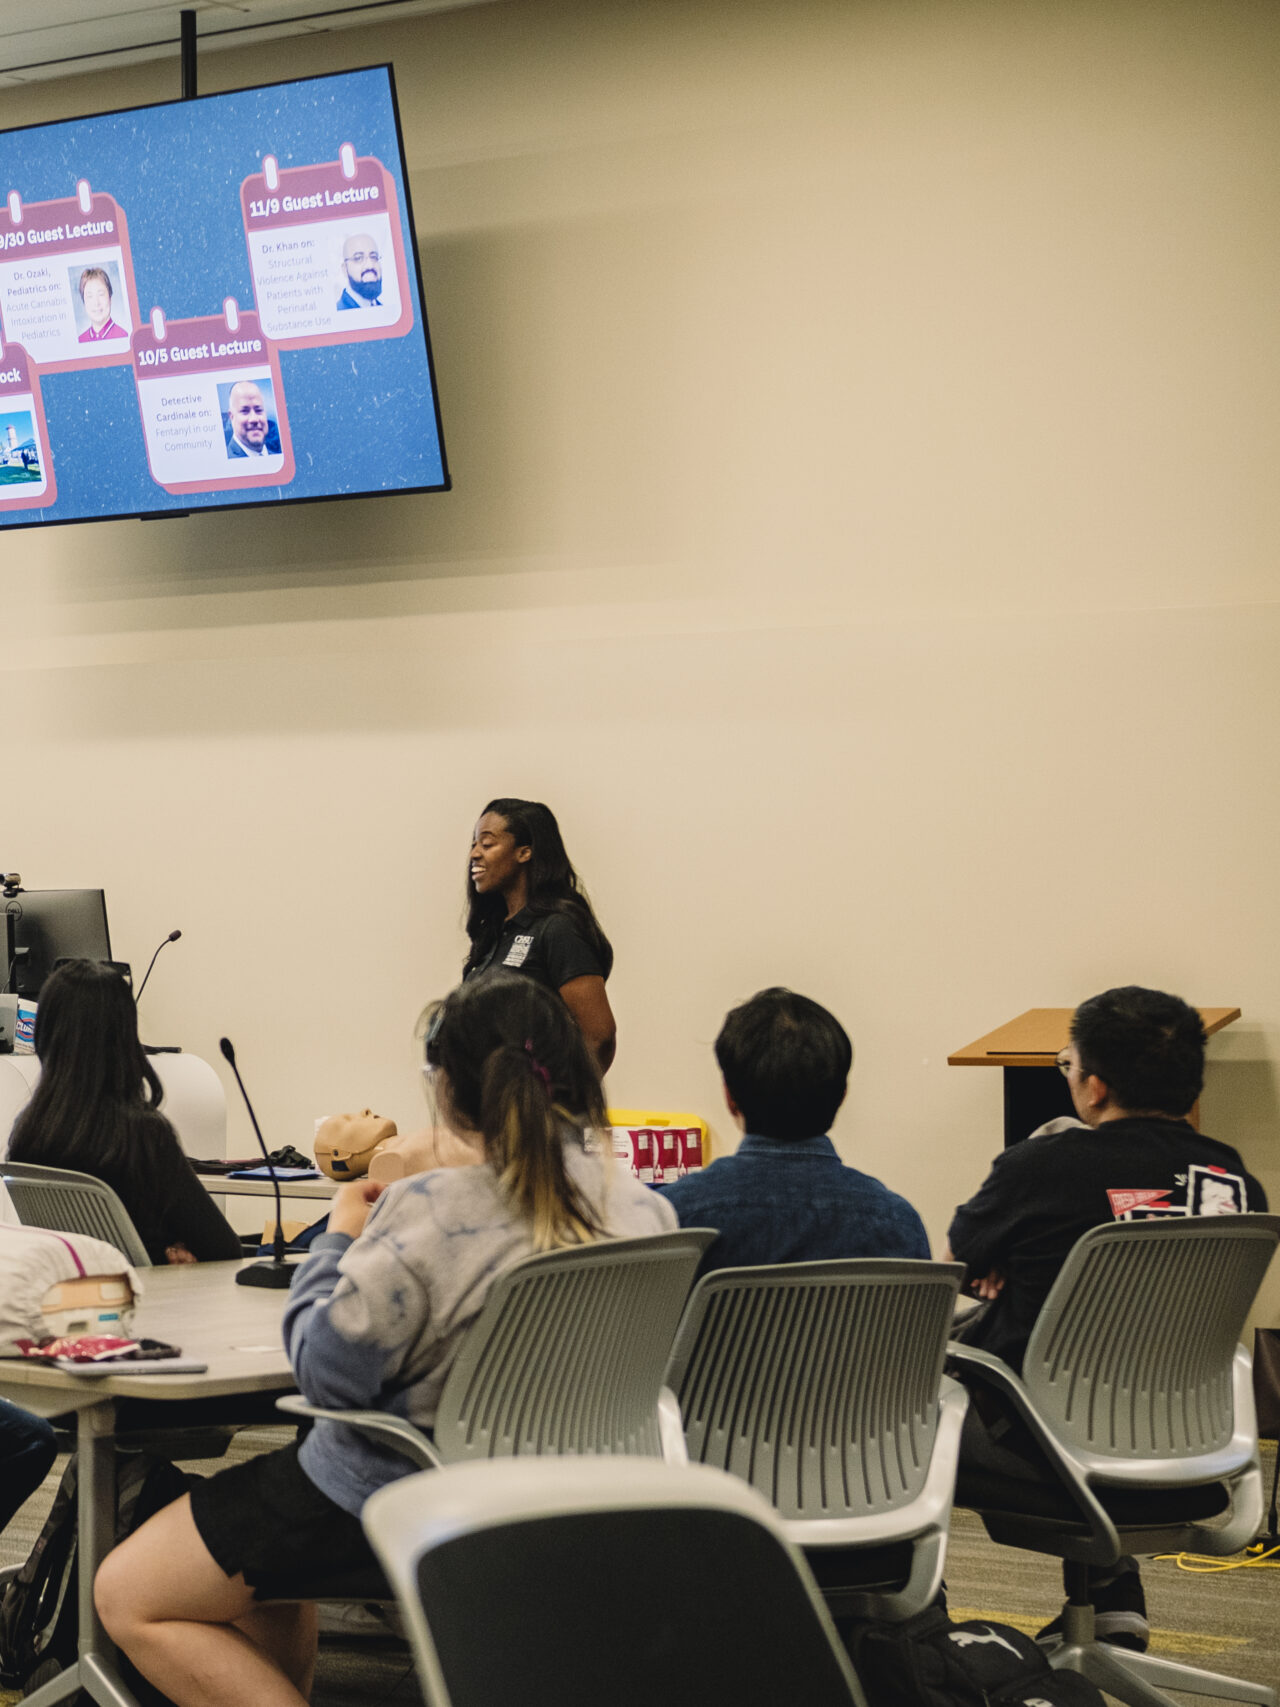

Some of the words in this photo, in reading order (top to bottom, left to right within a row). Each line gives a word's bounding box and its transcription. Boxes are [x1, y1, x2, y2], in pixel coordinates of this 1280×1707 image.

[250, 198, 280, 217] 11/9
[282, 192, 324, 212] Guest
[324, 186, 379, 206] Lecture
[27, 226, 64, 244] Guest
[65, 220, 114, 239] Lecture
[262, 244, 273, 254] Dr.
[276, 241, 299, 251] Khan
[300, 239, 315, 249] on:
[268, 255, 313, 269] Structural
[13, 271, 24, 281] Dr.
[257, 273, 294, 286] Violence
[296, 269, 328, 283] Against
[7, 285, 48, 296] Pediatrics
[48, 283, 61, 292] on:
[267, 288, 302, 300] Patients
[303, 285, 324, 297] with
[6, 302, 29, 312] Acute
[30, 296, 67, 309] Cannabis
[277, 302, 317, 315] Perinatal
[11, 315, 58, 327] Intoxication
[267, 318, 313, 332] Substance
[315, 317, 331, 326] Use
[22, 328, 61, 340] Pediatrics
[138, 347, 169, 366] 10/5
[170, 343, 209, 361] Guest
[210, 339, 262, 358] Lecture
[161, 394, 202, 407] Detective
[156, 410, 196, 422] Cardinale
[198, 409, 212, 418] on:
[155, 426, 193, 438] Fentanyl
[202, 424, 217, 433] our
[164, 439, 213, 452] Community
